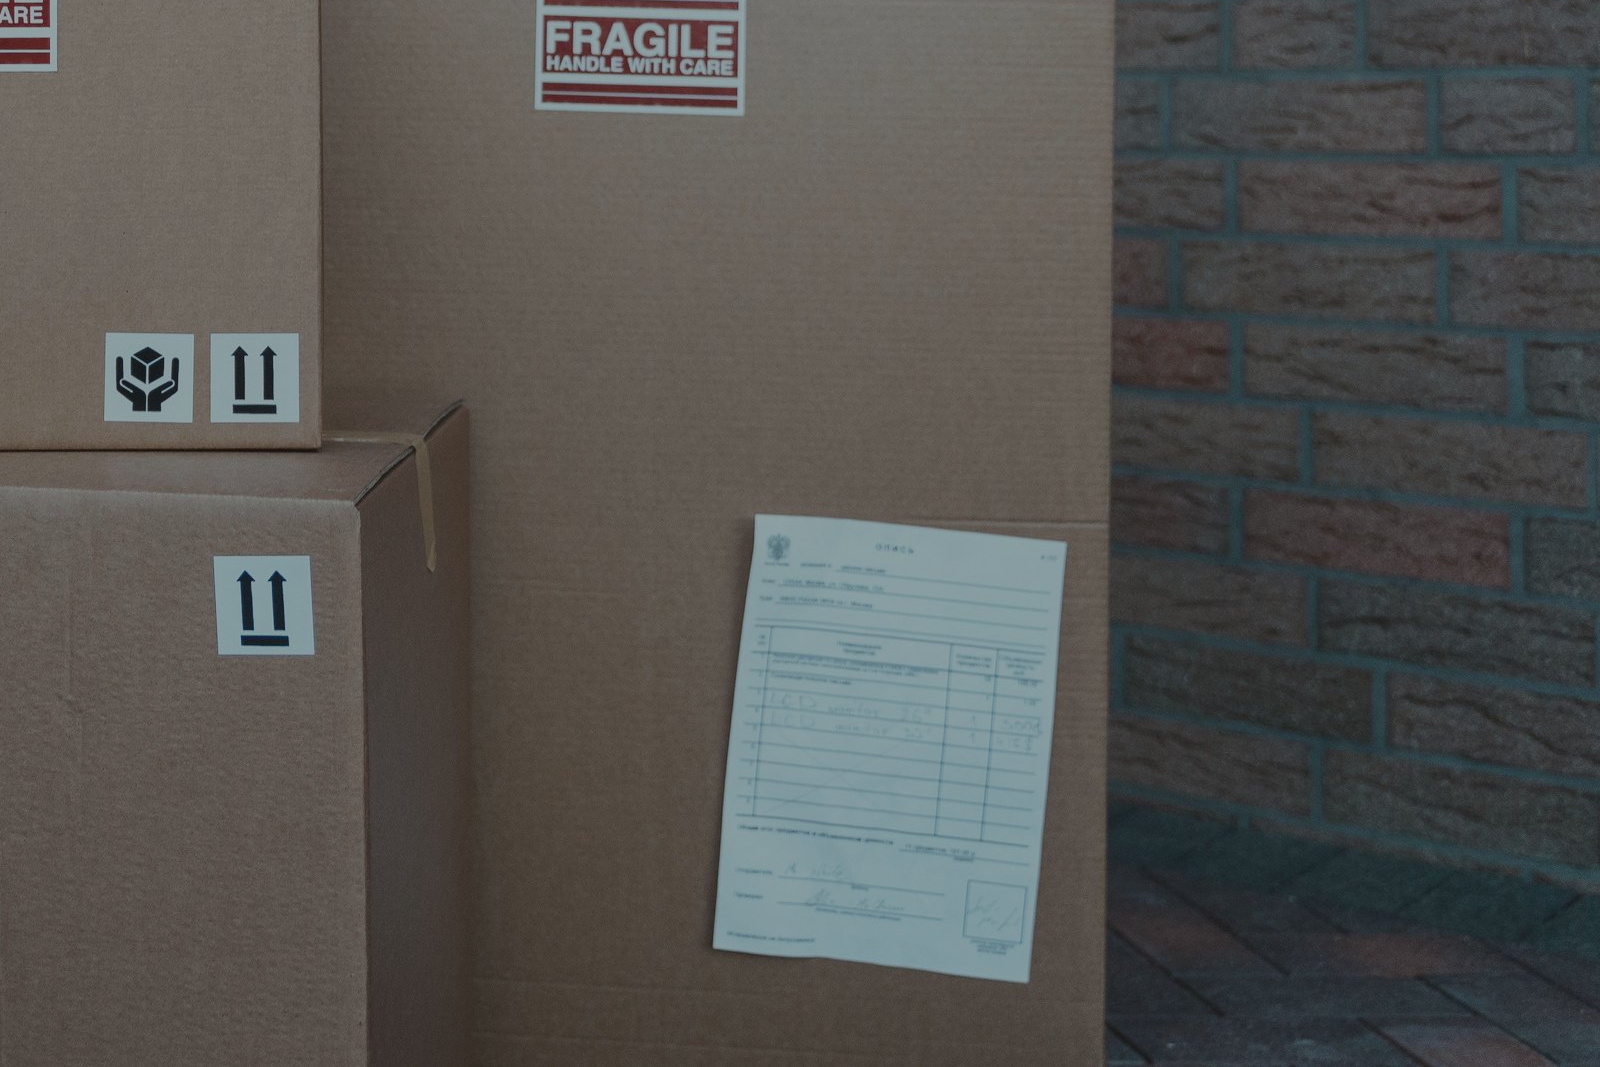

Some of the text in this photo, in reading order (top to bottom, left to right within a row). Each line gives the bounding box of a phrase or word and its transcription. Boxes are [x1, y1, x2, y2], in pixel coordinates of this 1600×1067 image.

[546, 20, 735, 59] FRAGILE
[546, 54, 734, 76] HANDLE WITH CARE
